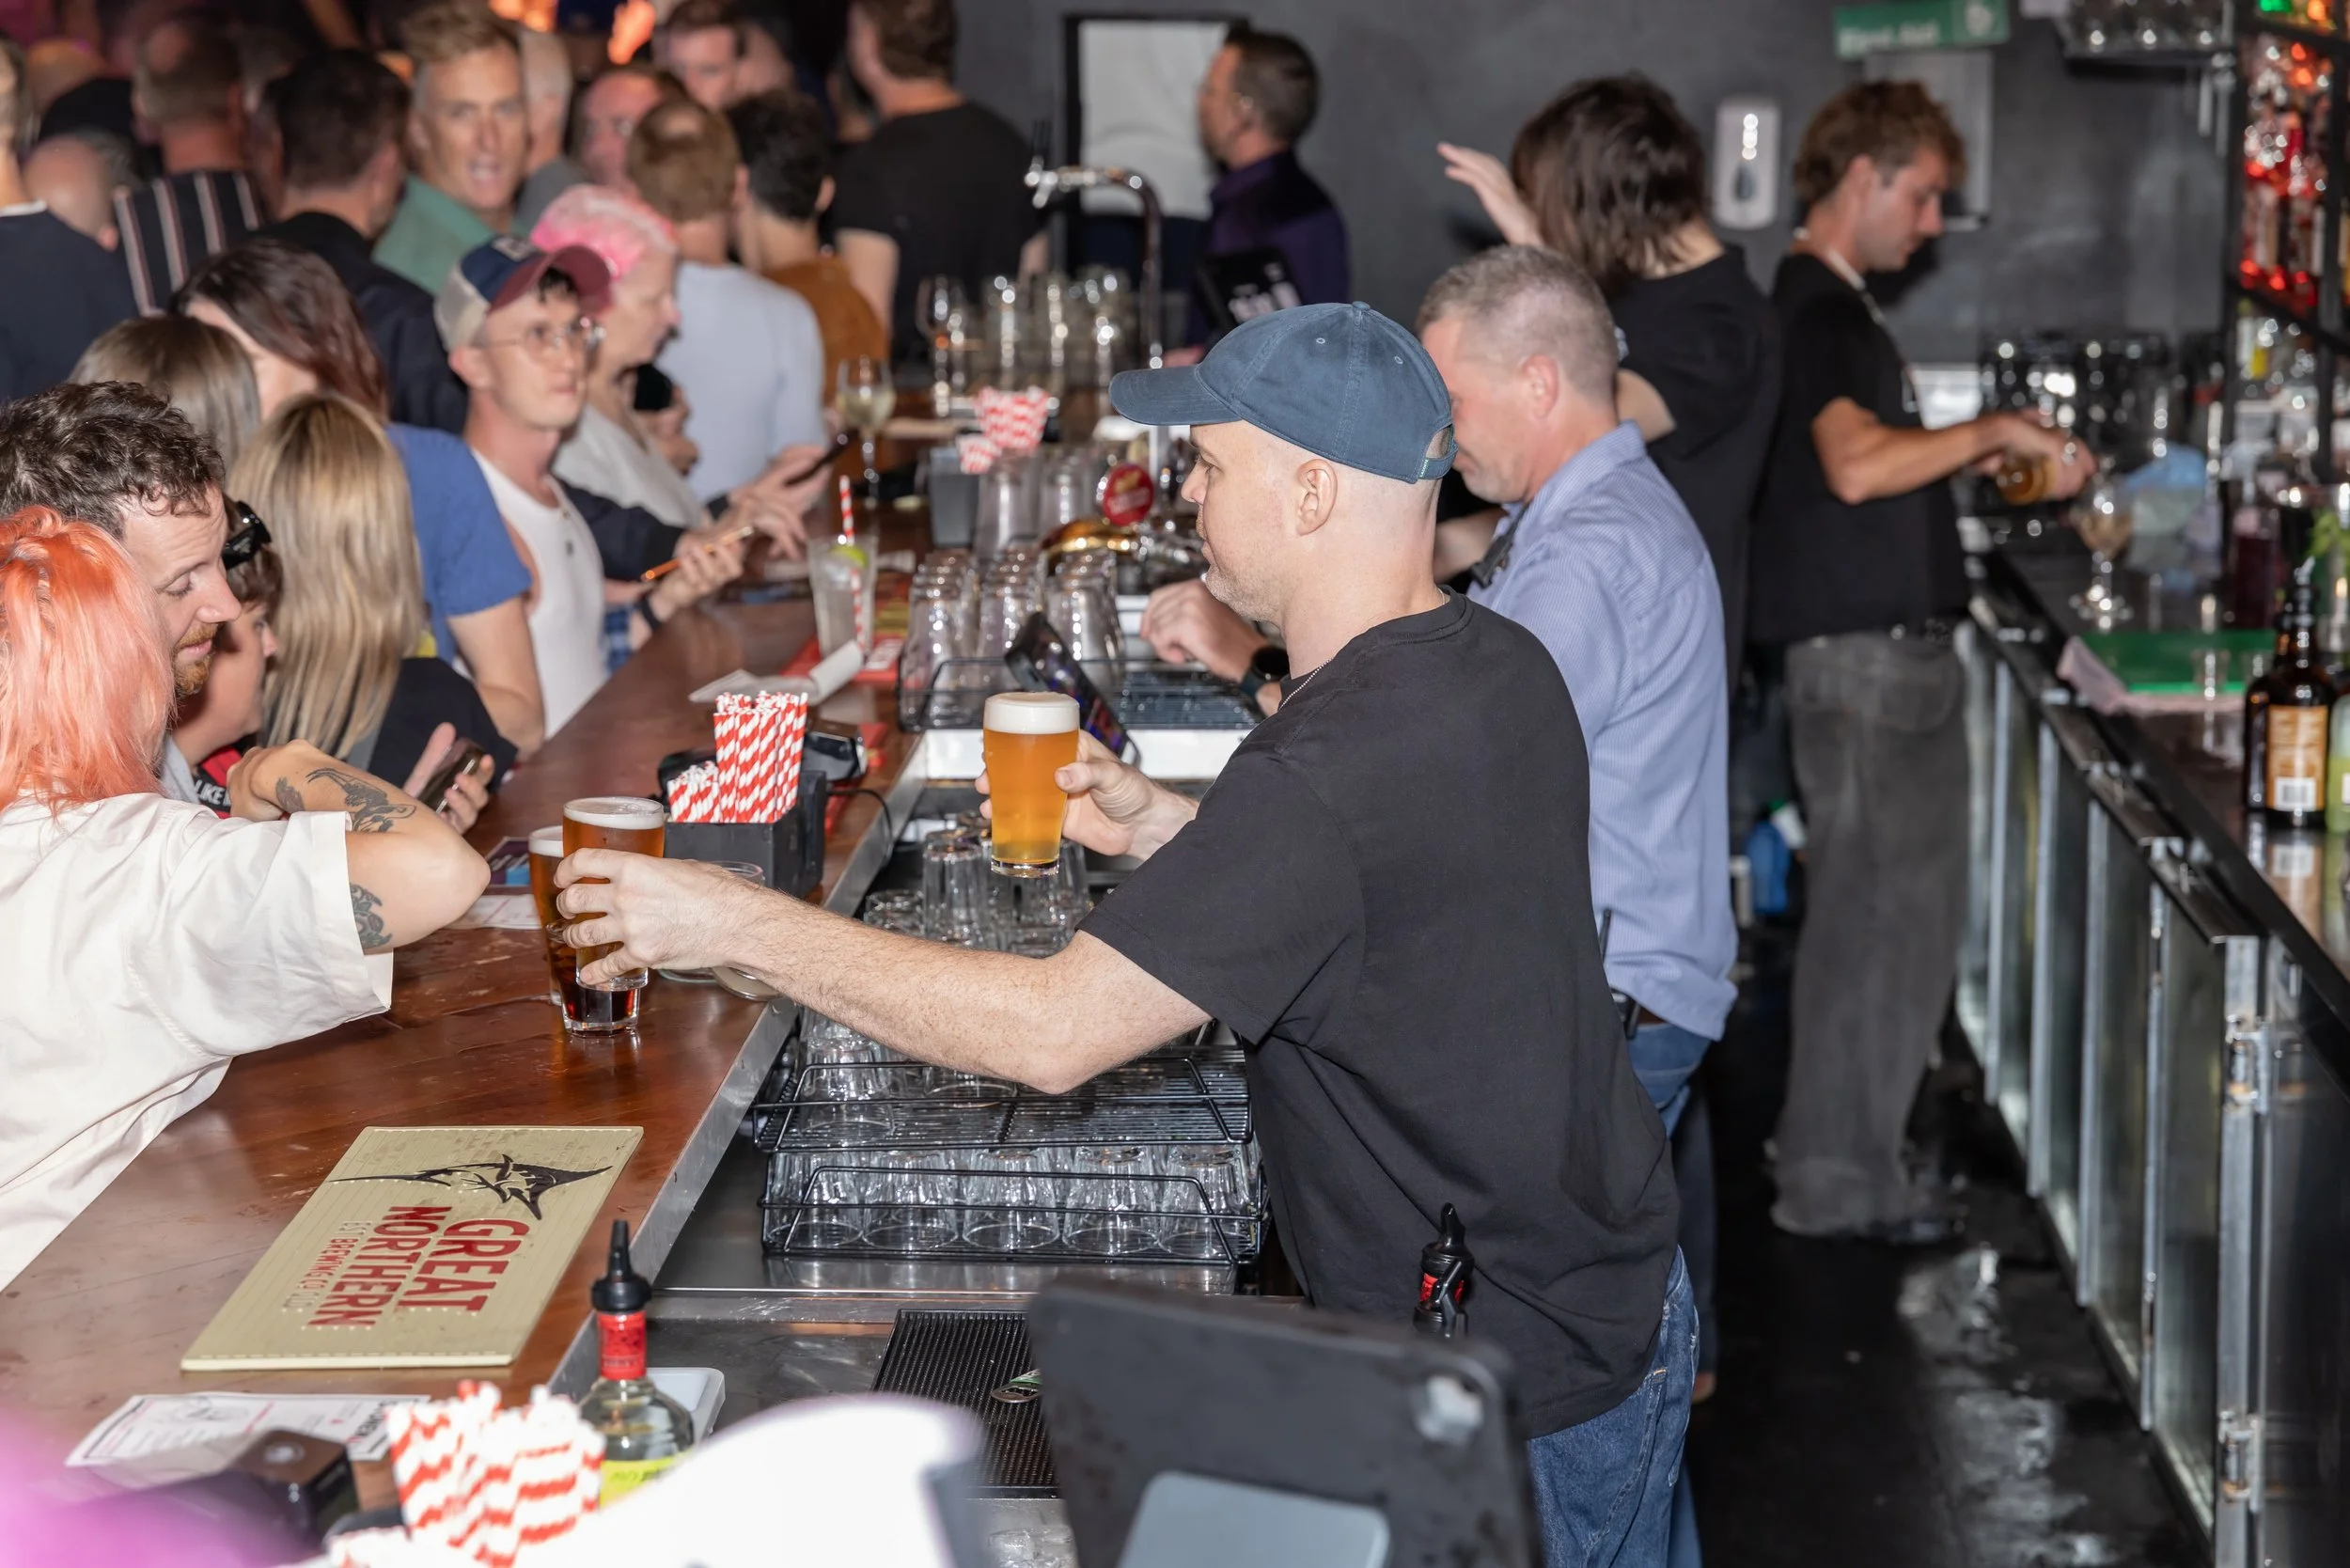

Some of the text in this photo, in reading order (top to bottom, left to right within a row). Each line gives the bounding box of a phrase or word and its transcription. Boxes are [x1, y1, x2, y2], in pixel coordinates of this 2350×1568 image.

[304, 1238, 359, 1277] BREWING
[307, 1206, 453, 1325] NORTHERN
[397, 1218, 530, 1311] GREAT
